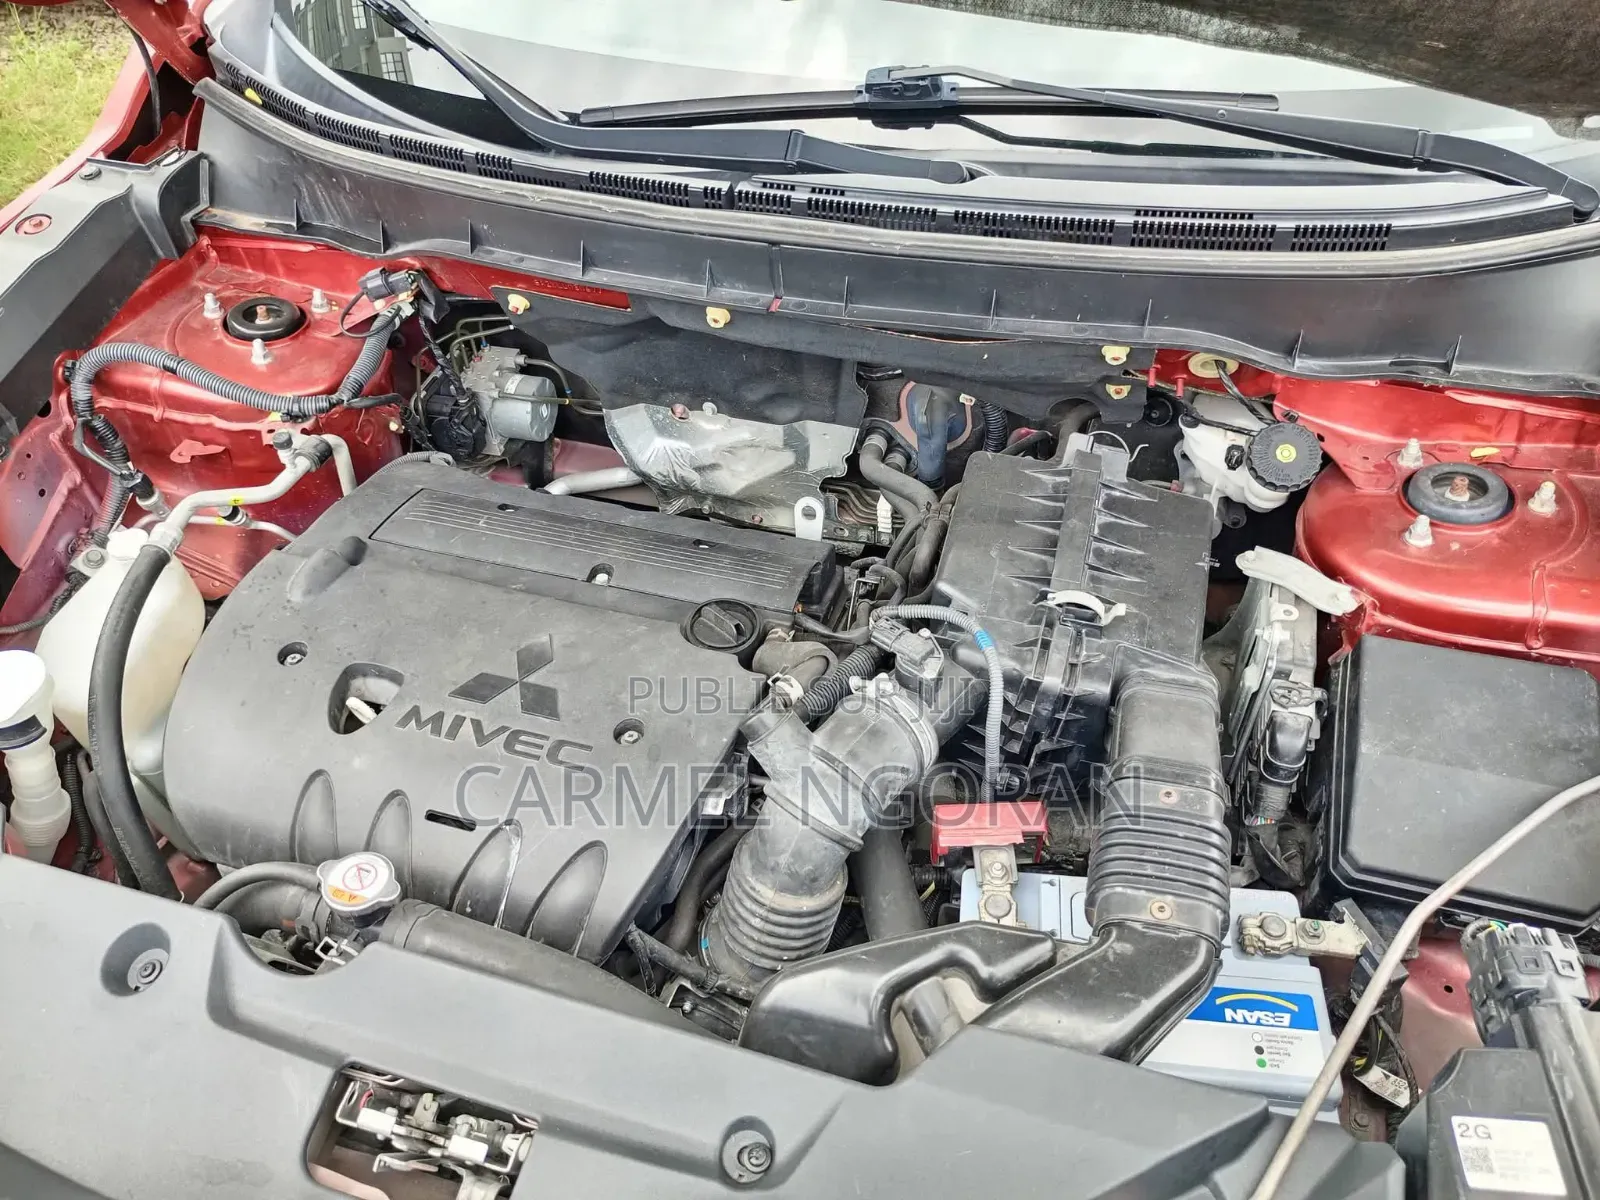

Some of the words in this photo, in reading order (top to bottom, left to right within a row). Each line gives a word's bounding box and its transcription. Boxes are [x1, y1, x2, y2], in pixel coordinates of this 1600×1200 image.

[394, 704, 594, 772] MIVEC
[1224, 1007, 1291, 1027] ESAN
[1457, 1122, 1492, 1140] 2G
